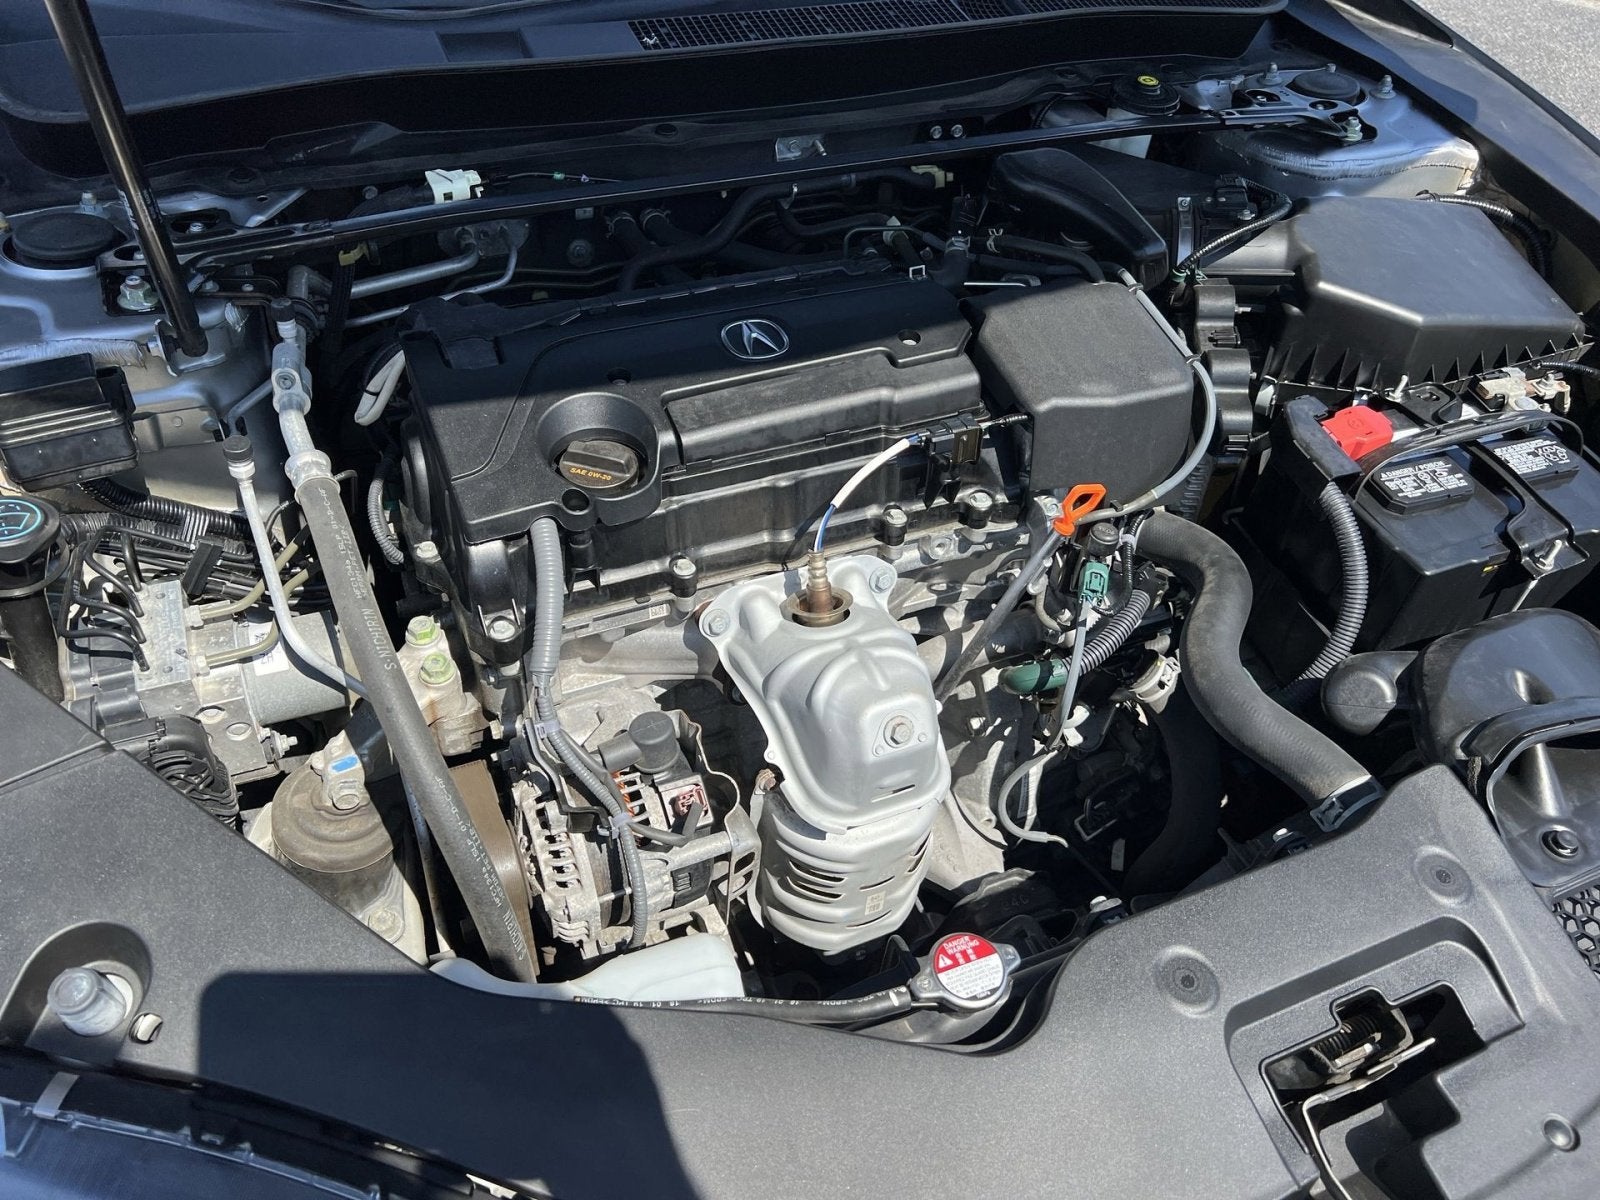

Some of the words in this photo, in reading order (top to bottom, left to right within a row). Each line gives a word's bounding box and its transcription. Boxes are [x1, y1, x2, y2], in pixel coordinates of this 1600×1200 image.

[570, 467, 586, 475] SAE
[588, 471, 612, 481] 0W-20
[943, 936, 969, 948] DANGER
[946, 939, 979, 954] WARNING
